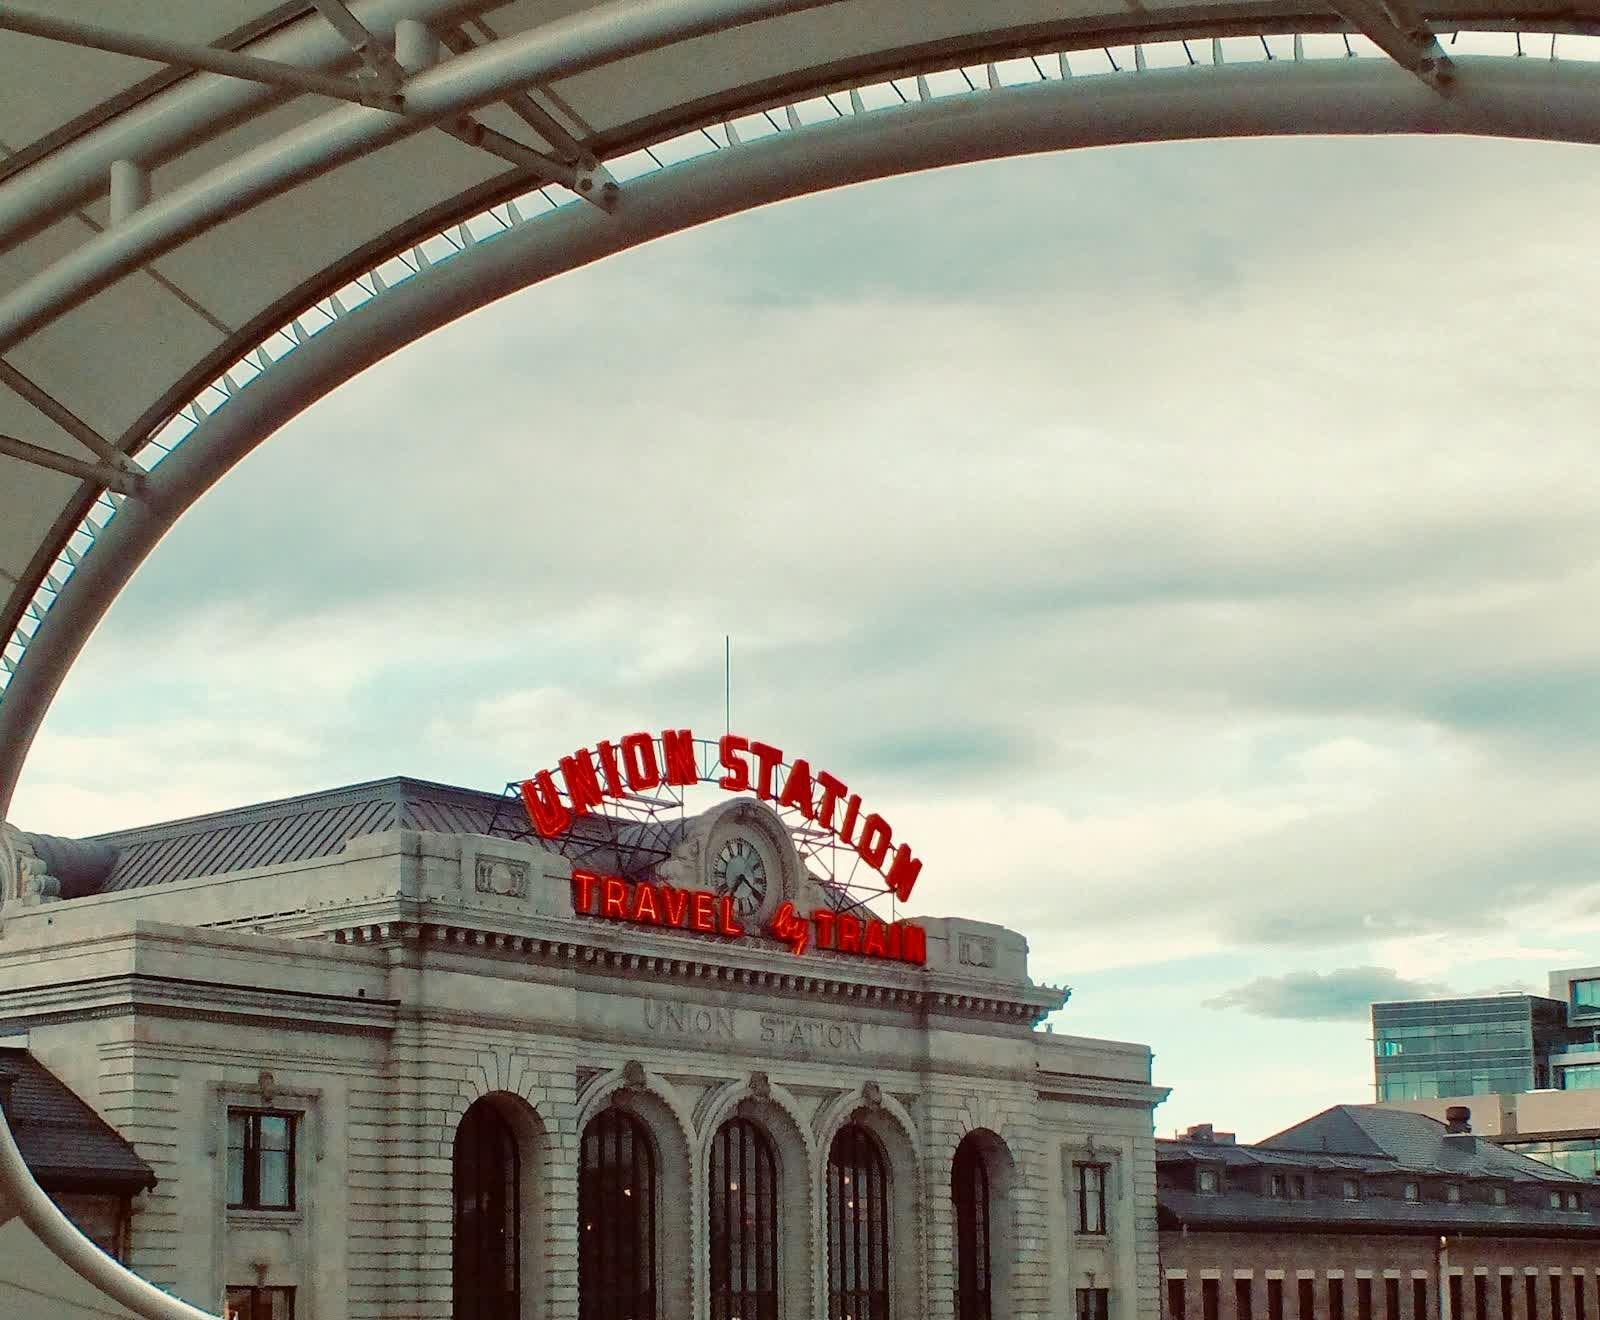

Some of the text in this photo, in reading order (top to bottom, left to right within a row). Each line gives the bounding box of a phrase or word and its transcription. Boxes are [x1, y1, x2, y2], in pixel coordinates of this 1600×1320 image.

[522, 729, 698, 837] UNION
[719, 735, 922, 902] STATION
[573, 871, 743, 936] TRAVEL
[773, 902, 809, 955] by
[814, 910, 927, 964] TRAIN
[643, 997, 863, 1050] UNION STATION
